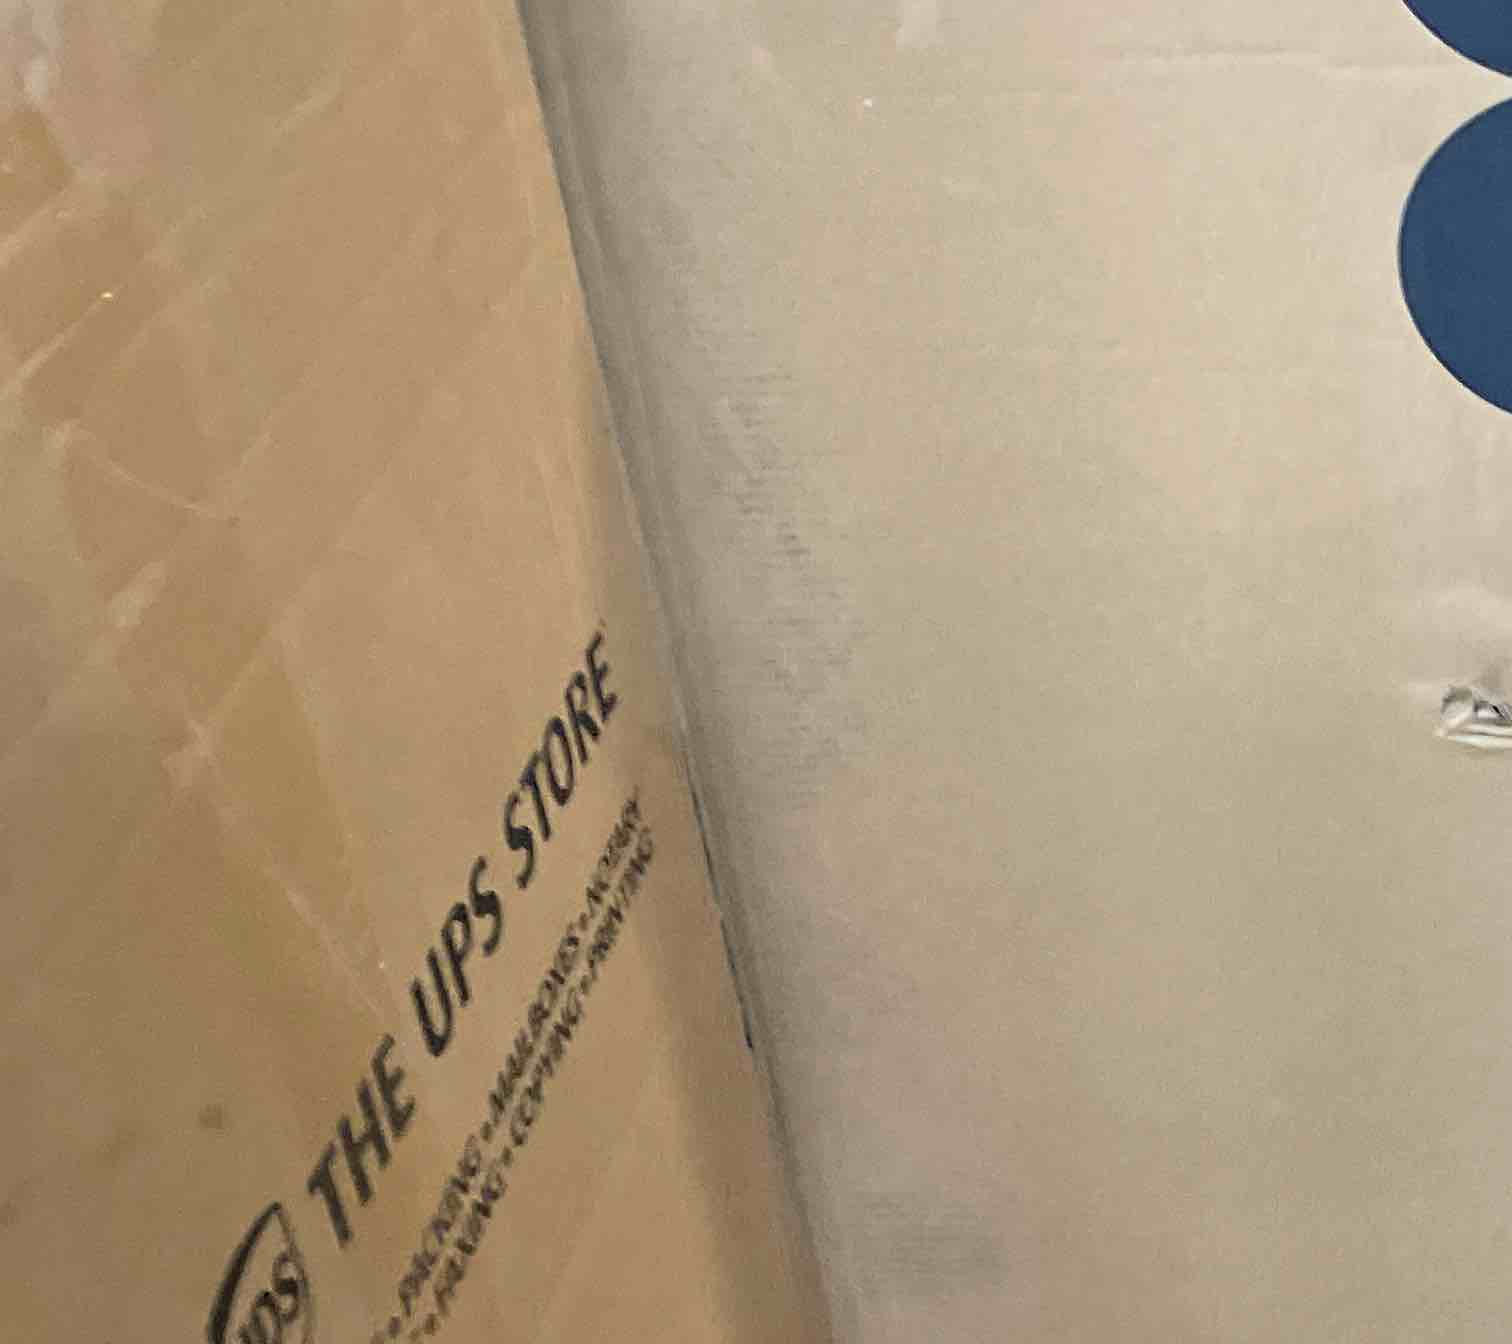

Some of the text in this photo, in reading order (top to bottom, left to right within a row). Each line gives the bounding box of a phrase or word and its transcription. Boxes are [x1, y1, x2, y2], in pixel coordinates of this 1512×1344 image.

[306, 624, 622, 1248] THE UPS STORE
